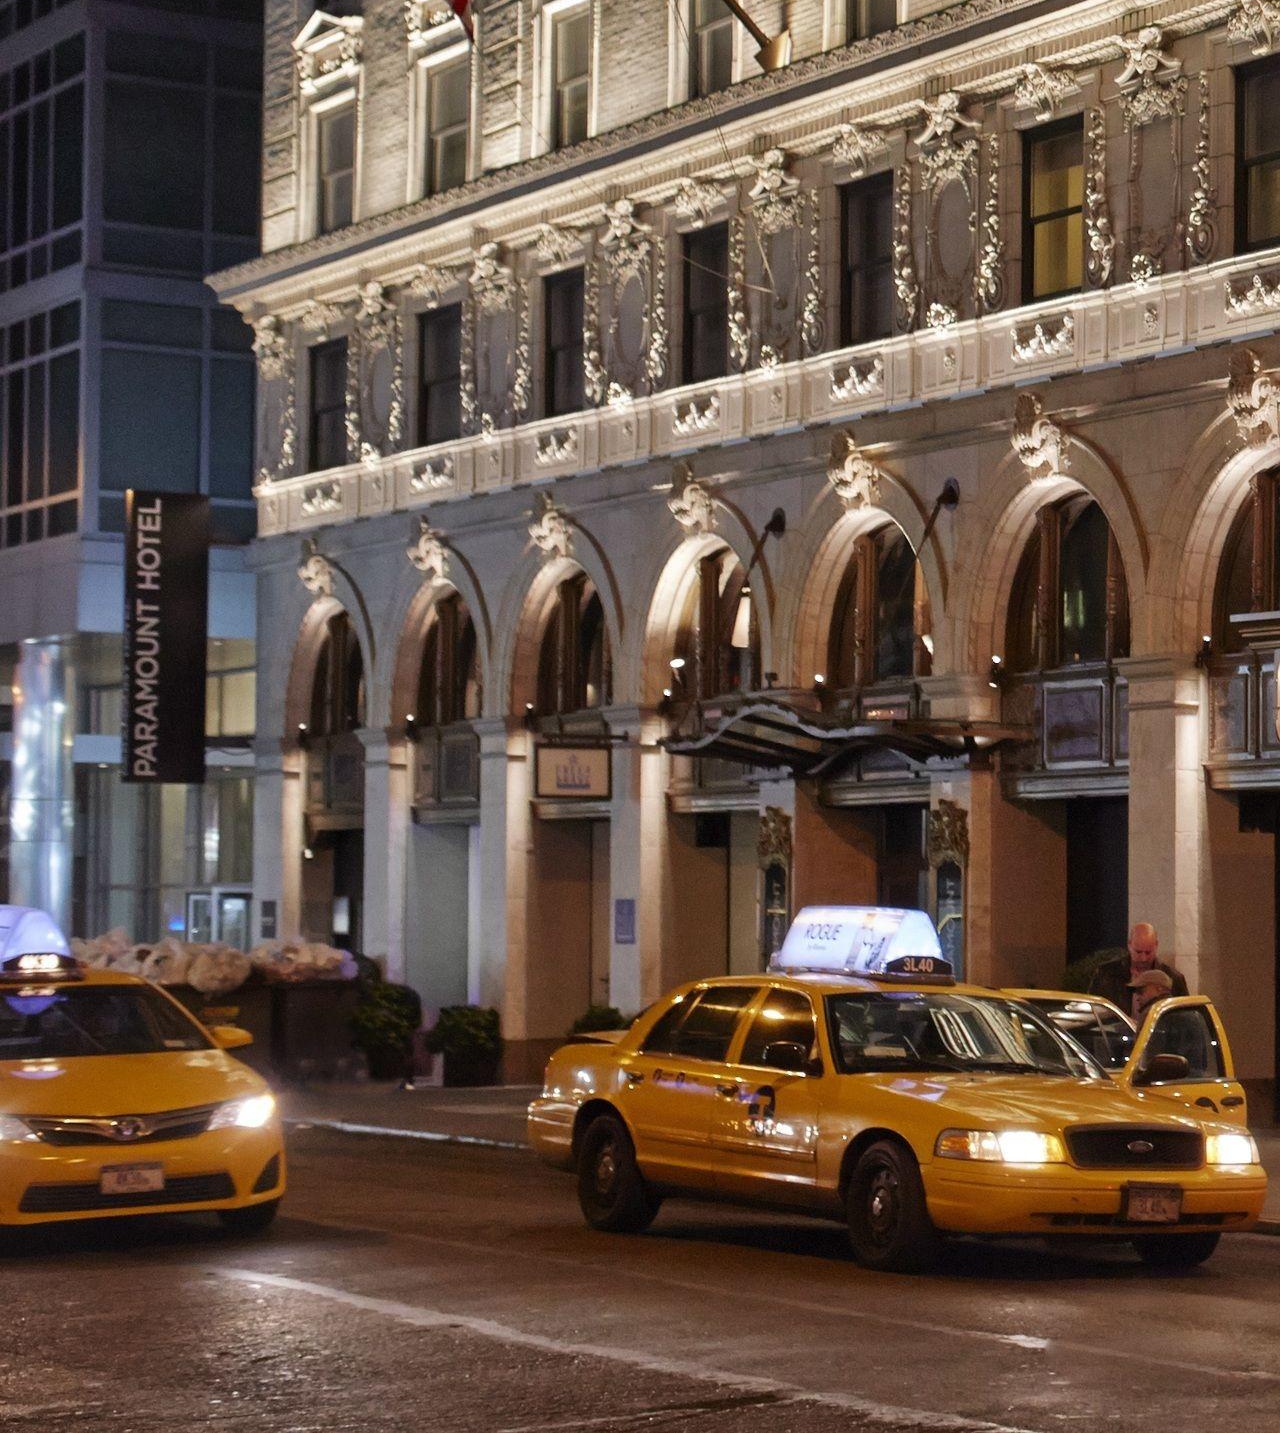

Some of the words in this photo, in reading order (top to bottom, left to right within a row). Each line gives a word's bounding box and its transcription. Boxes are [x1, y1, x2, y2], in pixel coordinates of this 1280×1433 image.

[136, 498, 162, 590] HOTEL
[133, 599, 161, 777] PARAMOUNT
[903, 957, 934, 973] 3L40
